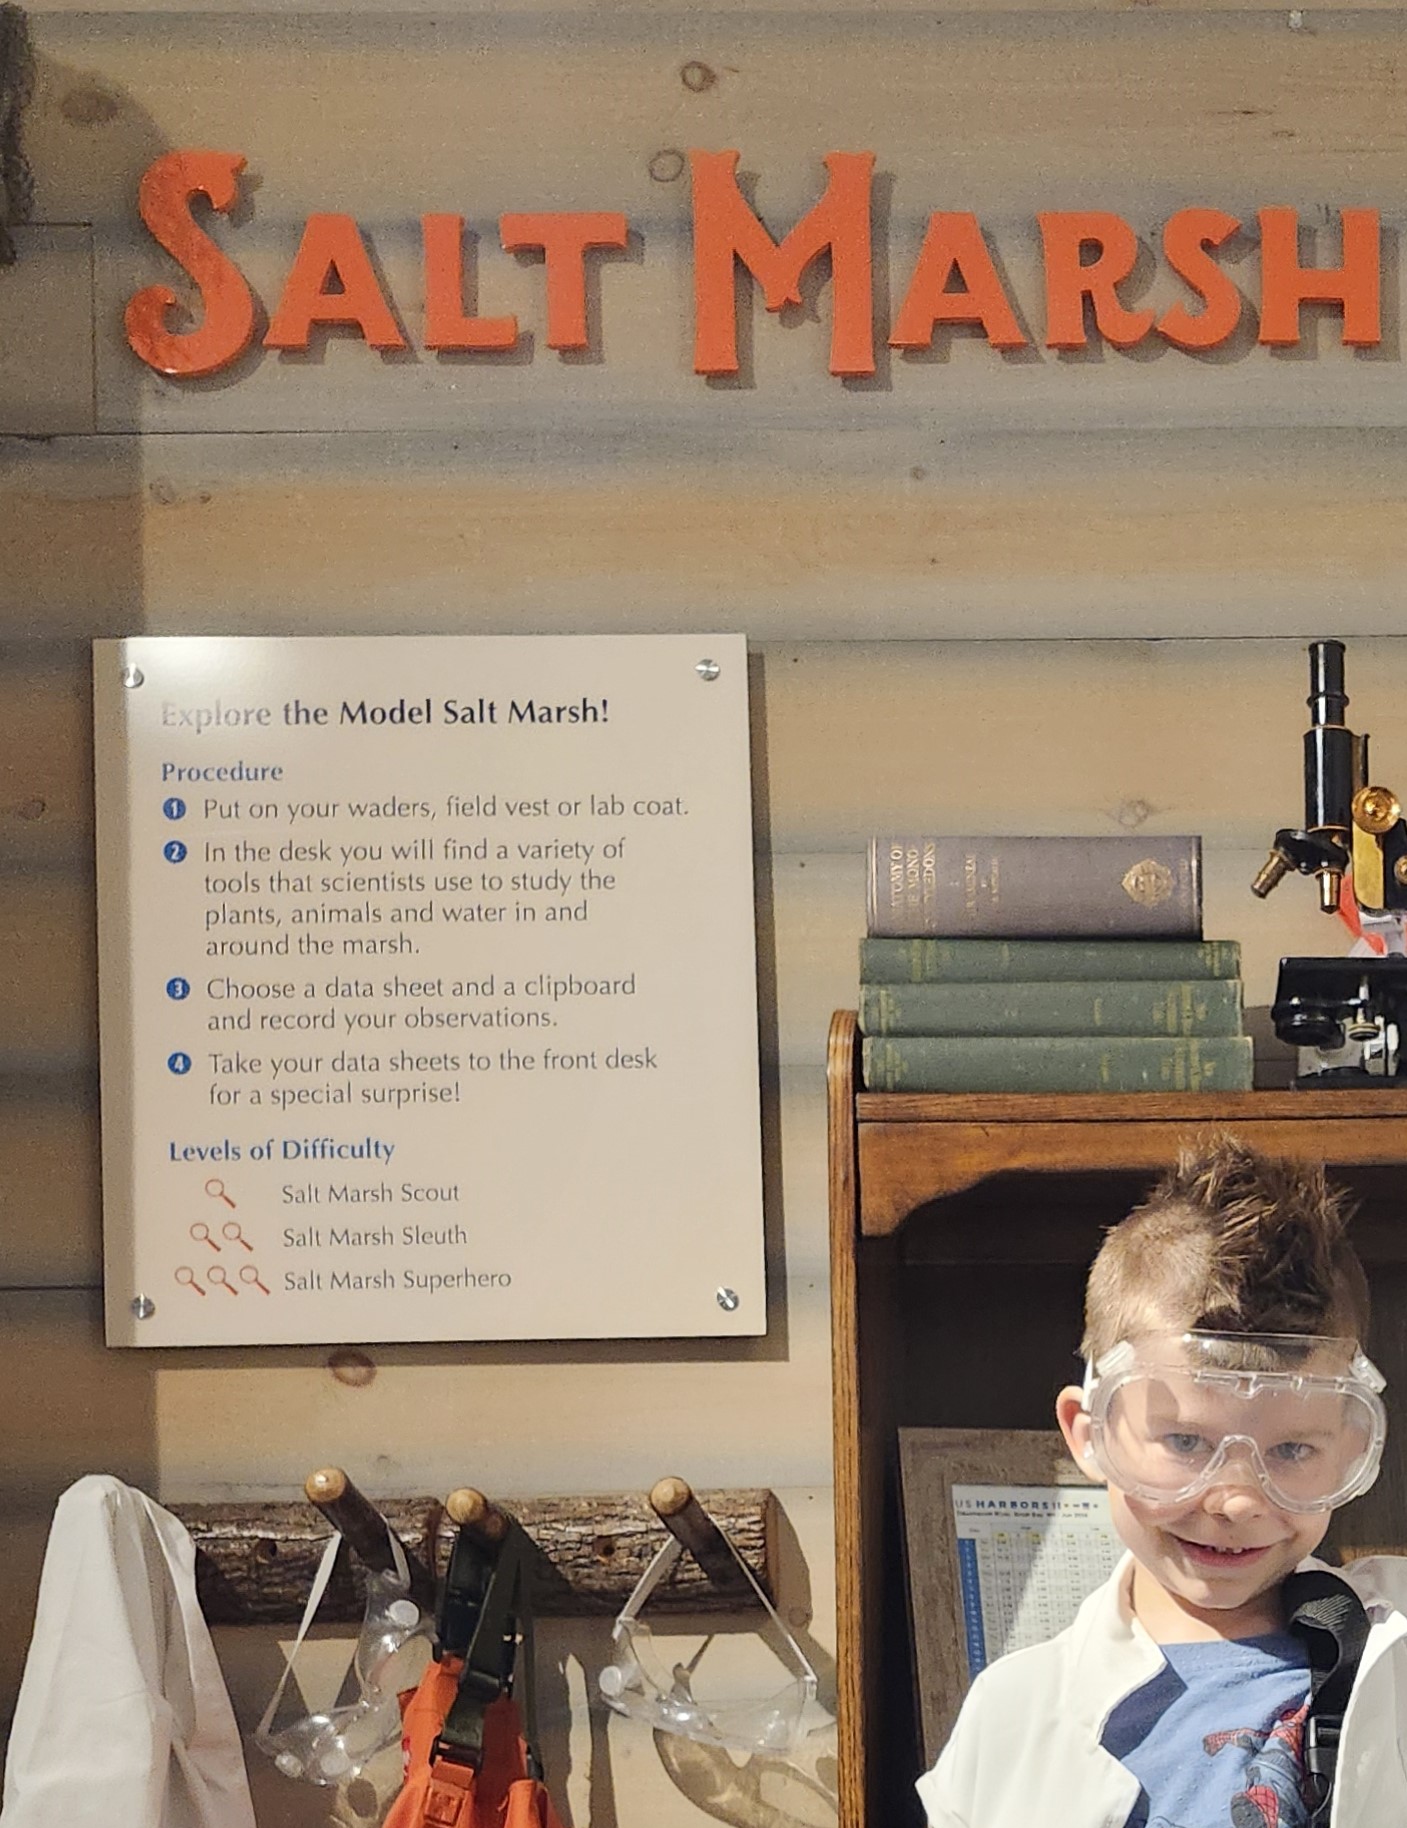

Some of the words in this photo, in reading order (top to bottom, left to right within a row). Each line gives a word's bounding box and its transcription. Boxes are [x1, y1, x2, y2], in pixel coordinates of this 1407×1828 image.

[162, 699, 271, 735] Explore
[284, 700, 328, 725] the
[340, 698, 431, 724] Model
[444, 698, 497, 724] Salt
[509, 698, 608, 723] Marsh!
[162, 761, 283, 782] Procedure
[205, 799, 240, 819] Put
[249, 803, 278, 819] on
[287, 802, 340, 824] your
[348, 797, 436, 821] waders,
[447, 796, 496, 817] field
[505, 799, 549, 817] vest
[558, 801, 581, 816] or
[591, 796, 624, 816] lab
[633, 797, 688, 816] coat.
[206, 842, 225, 862] In
[235, 840, 270, 862] the
[280, 840, 331, 862] desk
[340, 845, 382, 867] you
[391, 837, 433, 860] will
[443, 838, 487, 860] find
[496, 845, 508, 860] a
[517, 839, 594, 866] variety
[603, 837, 626, 859] of
[205, 871, 260, 894] tools
[269, 870, 312, 893] that
[321, 870, 425, 893] scientists
[435, 876, 472, 891] use
[481, 873, 503, 891] to
[511, 869, 571, 897] study
[580, 869, 615, 890] the
[206, 902, 281, 932] plants,
[292, 901, 381, 924] animals
[391, 901, 433, 923] and
[442, 904, 507, 922] water
[516, 901, 535, 922] in
[545, 900, 587, 921] and
[206, 933, 289, 956] around
[298, 933, 334, 955] the
[343, 932, 419, 955] marsh.
[207, 976, 295, 1000] Choose
[304, 983, 315, 998] a
[326, 976, 373, 998] data
[384, 975, 443, 997] sheet
[452, 974, 494, 997] and
[504, 982, 515, 996] a
[525, 973, 635, 1002] clipboard
[208, 1007, 251, 1031] and
[261, 1006, 335, 1030] record
[344, 1013, 397, 1035] your
[405, 1006, 557, 1028] observations.
[208, 1051, 261, 1074] Take
[271, 1057, 323, 1080] your
[332, 1050, 379, 1072] data
[389, 1049, 460, 1072] sheets
[469, 1053, 490, 1071] to
[500, 1049, 535, 1070] the
[544, 1048, 597, 1070] front
[605, 1047, 657, 1069] desk
[210, 1083, 241, 1105] for
[250, 1089, 261, 1105] a
[271, 1081, 351, 1111] special
[361, 1082, 459, 1109] surprise!
[170, 1139, 241, 1161] Levels
[250, 1139, 274, 1160] of
[283, 1137, 394, 1165] Difficulty
[282, 1183, 320, 1204] Salt
[329, 1182, 392, 1203] Marsh
[401, 1182, 459, 1202] Scout
[284, 1226, 321, 1247] Salt
[330, 1225, 393, 1246] Marsh
[403, 1224, 467, 1245] Sleuth
[285, 1269, 322, 1291] Salt
[330, 1269, 395, 1290] Marsh
[403, 1267, 511, 1295] Superhero
[976, 1500, 1049, 1510] HARBORS
